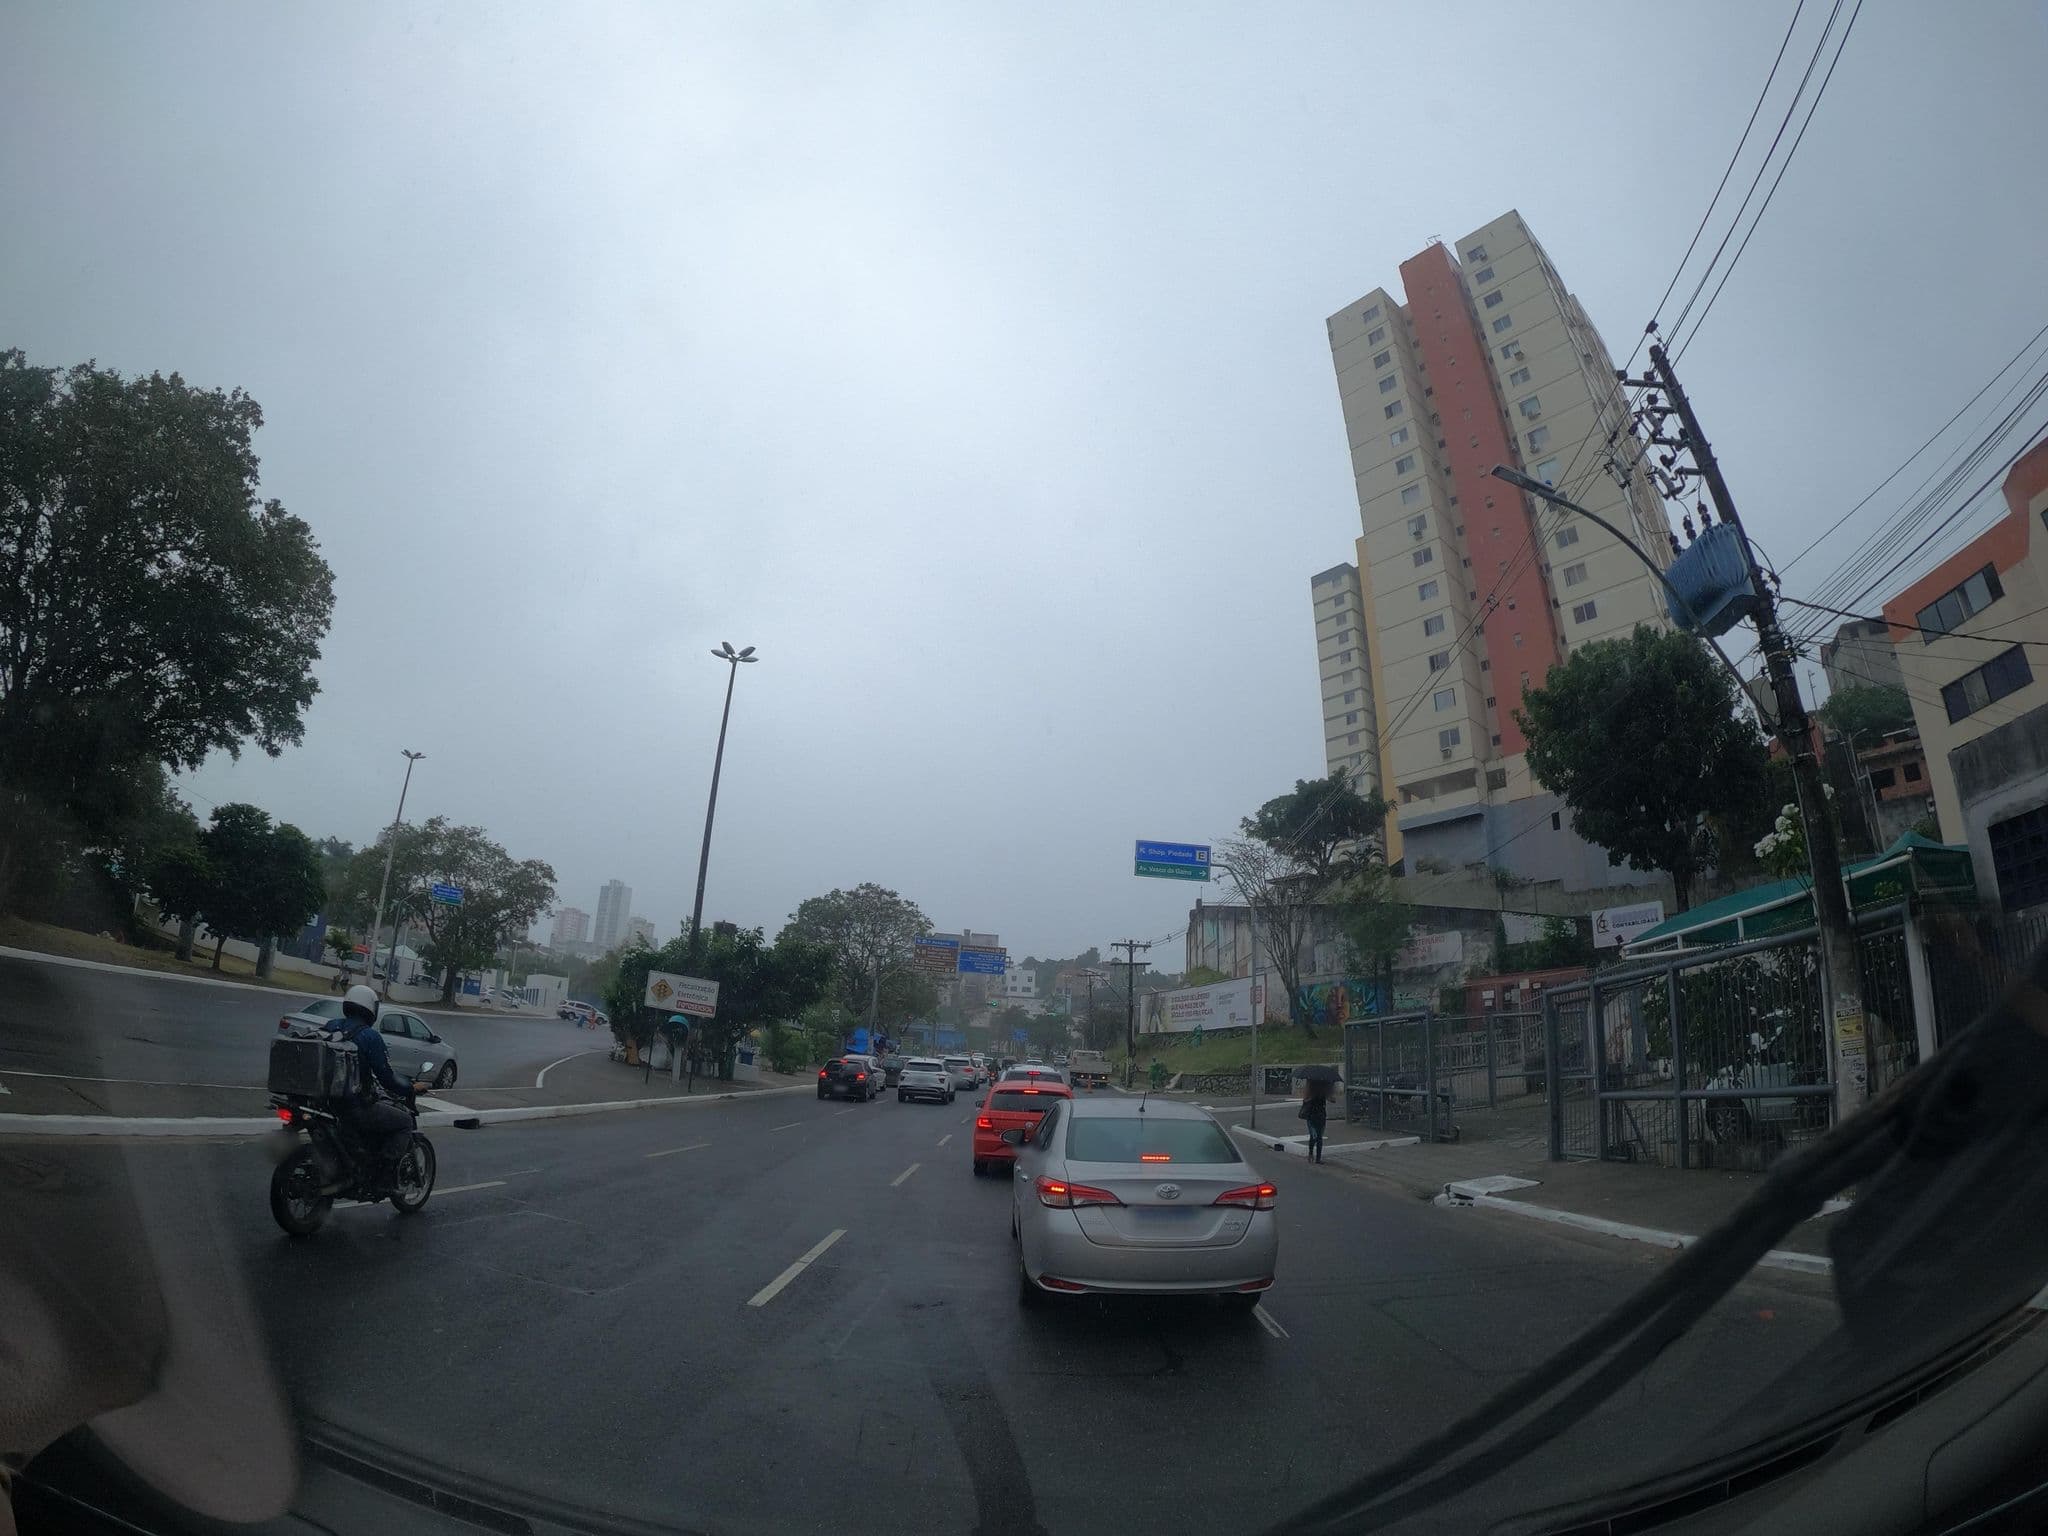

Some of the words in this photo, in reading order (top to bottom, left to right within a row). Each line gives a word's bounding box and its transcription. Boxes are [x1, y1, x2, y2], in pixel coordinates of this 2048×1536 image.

[1168, 849, 1193, 858] Piedade
[1175, 868, 1192, 876] Gama
[1612, 918, 1659, 929] CONTABILIDADE
